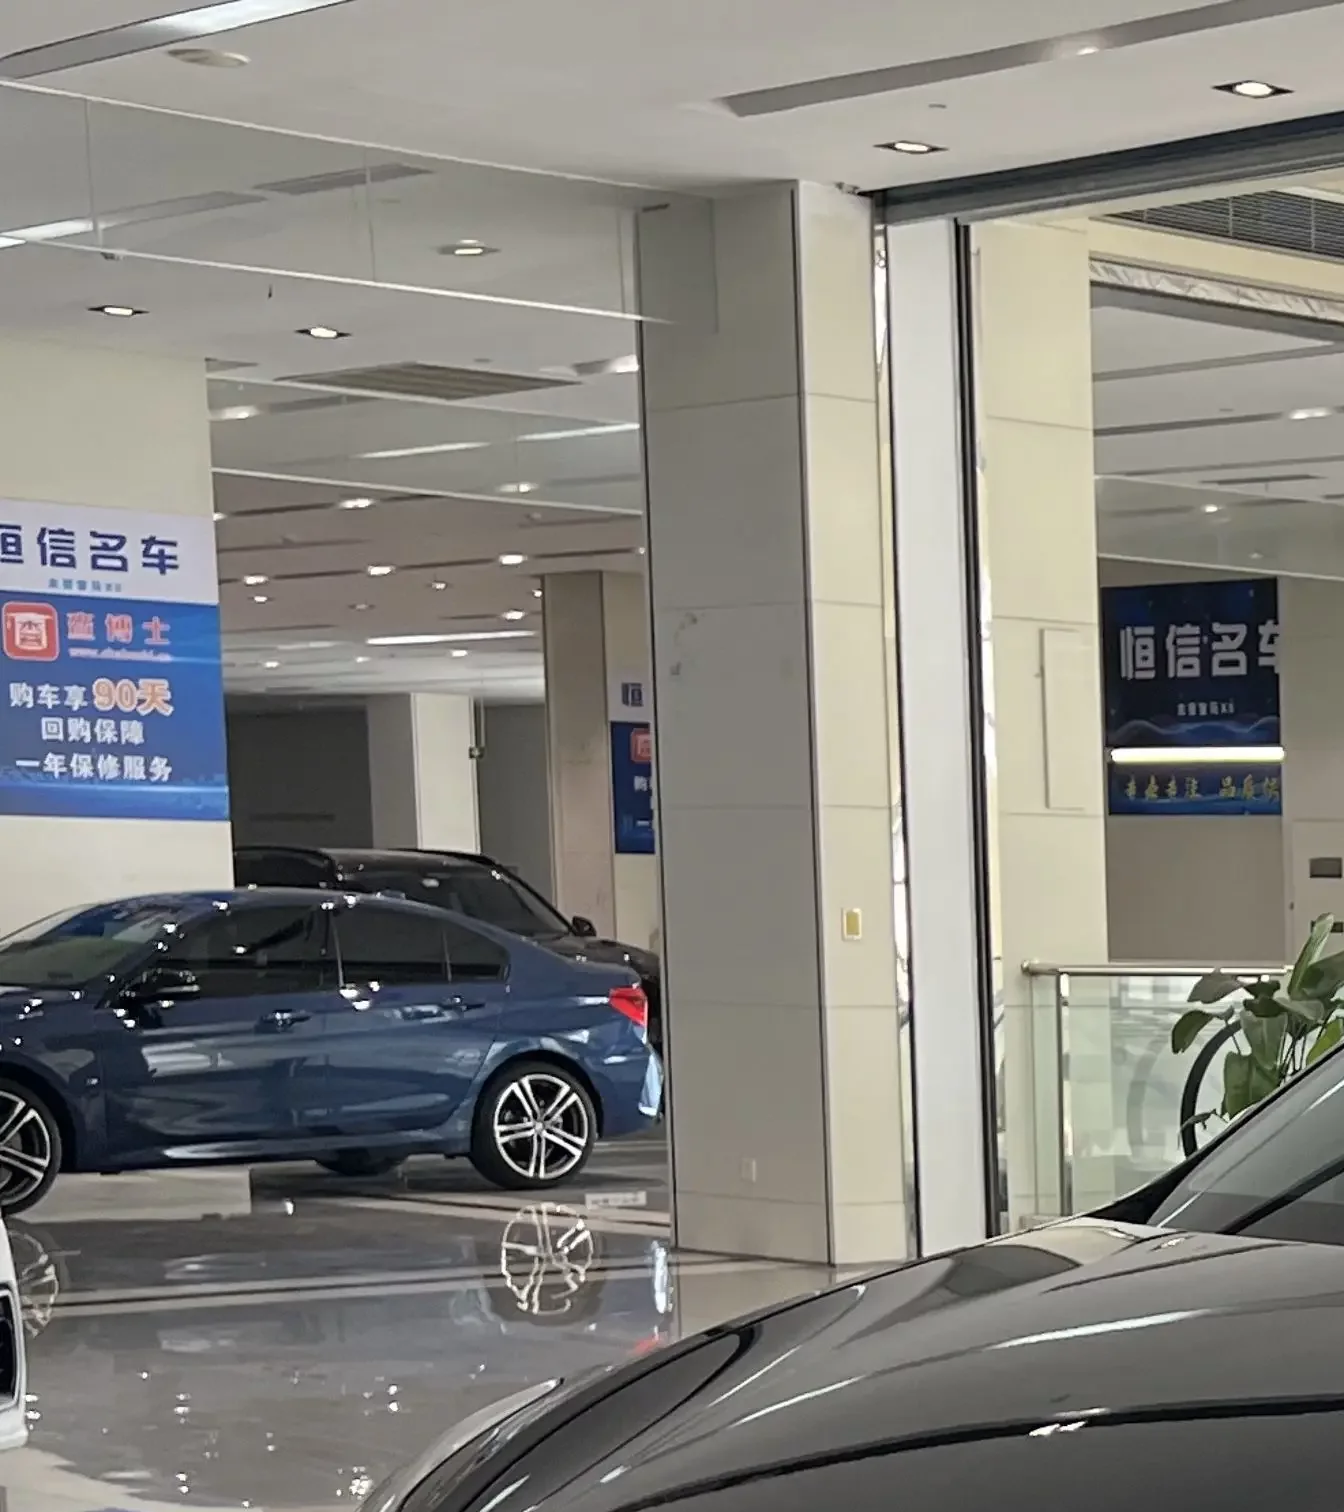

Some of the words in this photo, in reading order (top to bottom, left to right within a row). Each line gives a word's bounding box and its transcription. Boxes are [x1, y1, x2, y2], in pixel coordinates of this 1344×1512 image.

[1120, 620, 1279, 680] 恒信名车
[41, 716, 145, 746] 回购保障
[16, 751, 173, 783] 一年保修服务
